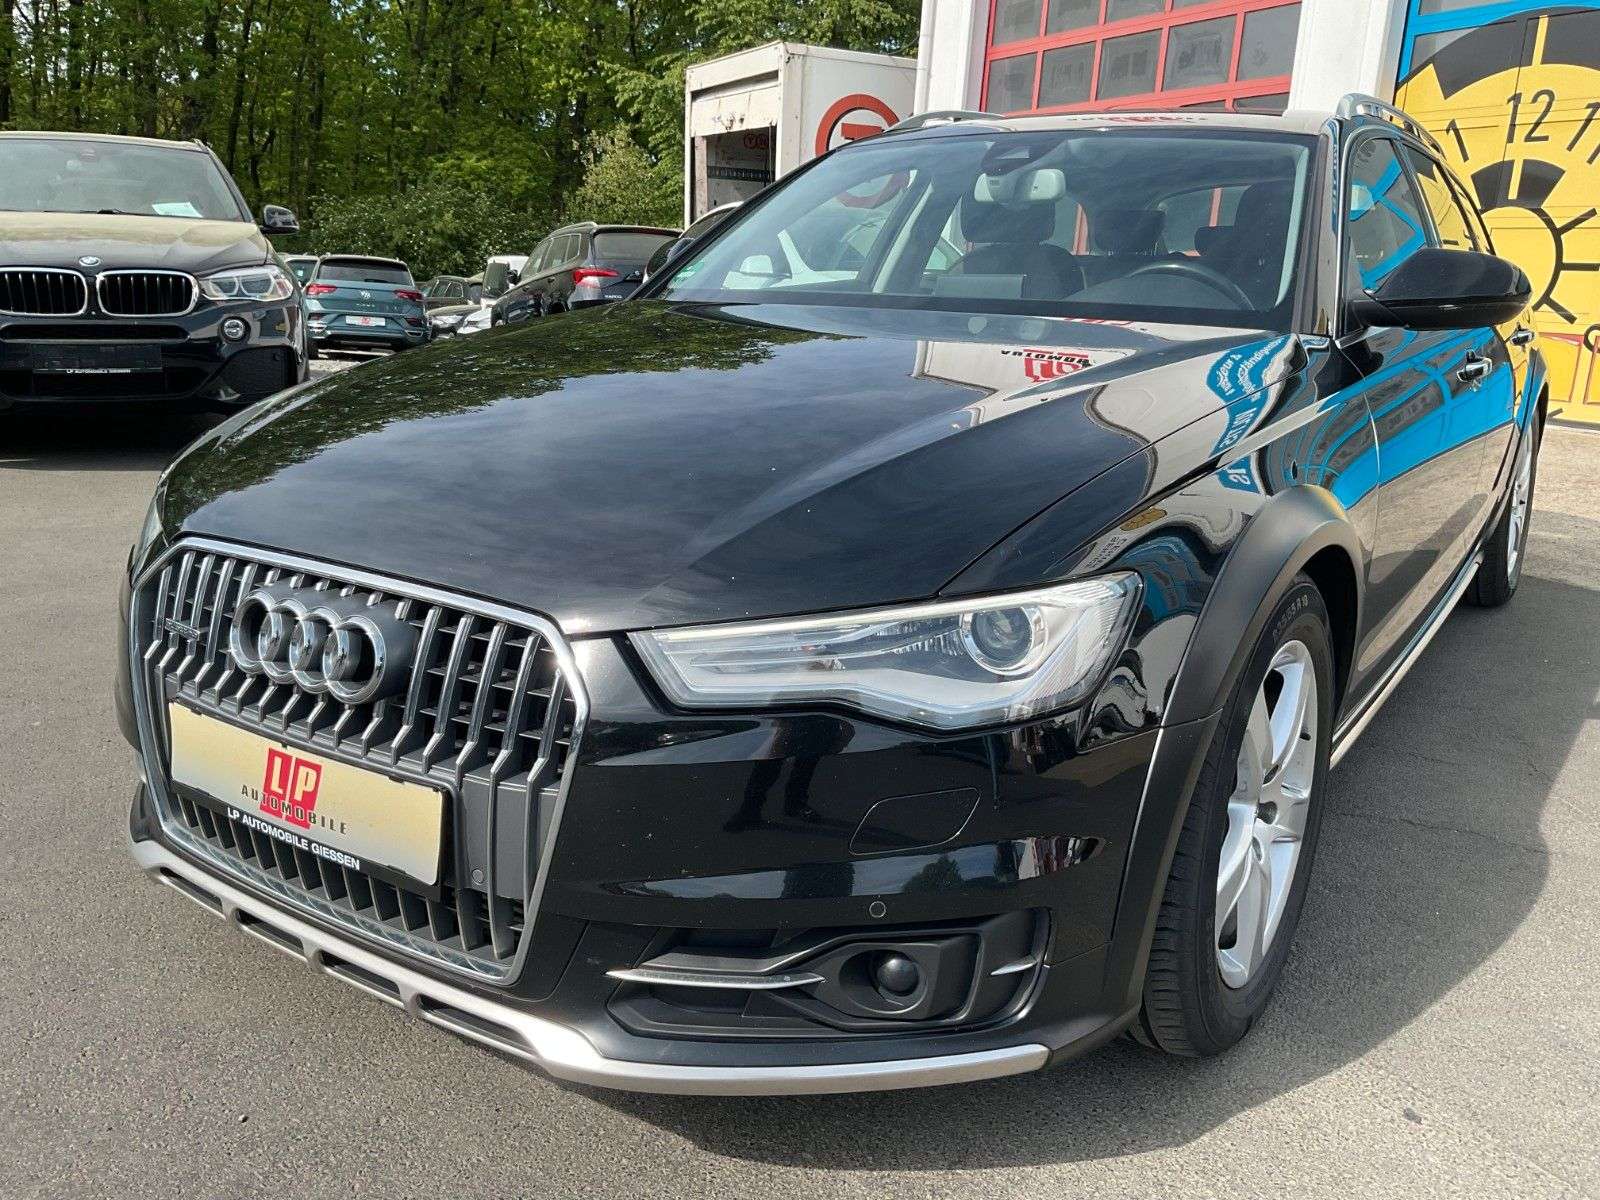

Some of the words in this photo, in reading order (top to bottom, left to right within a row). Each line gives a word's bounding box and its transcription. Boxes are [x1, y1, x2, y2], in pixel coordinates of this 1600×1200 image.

[1446, 118, 1470, 163] 1
[1507, 89, 1555, 144] 12
[270, 756, 318, 802] LP
[241, 784, 349, 835] AUTOMOBILE
[227, 807, 240, 820] LP
[242, 814, 309, 851] AUTOMOBILE
[312, 843, 360, 871] GIESSEN
